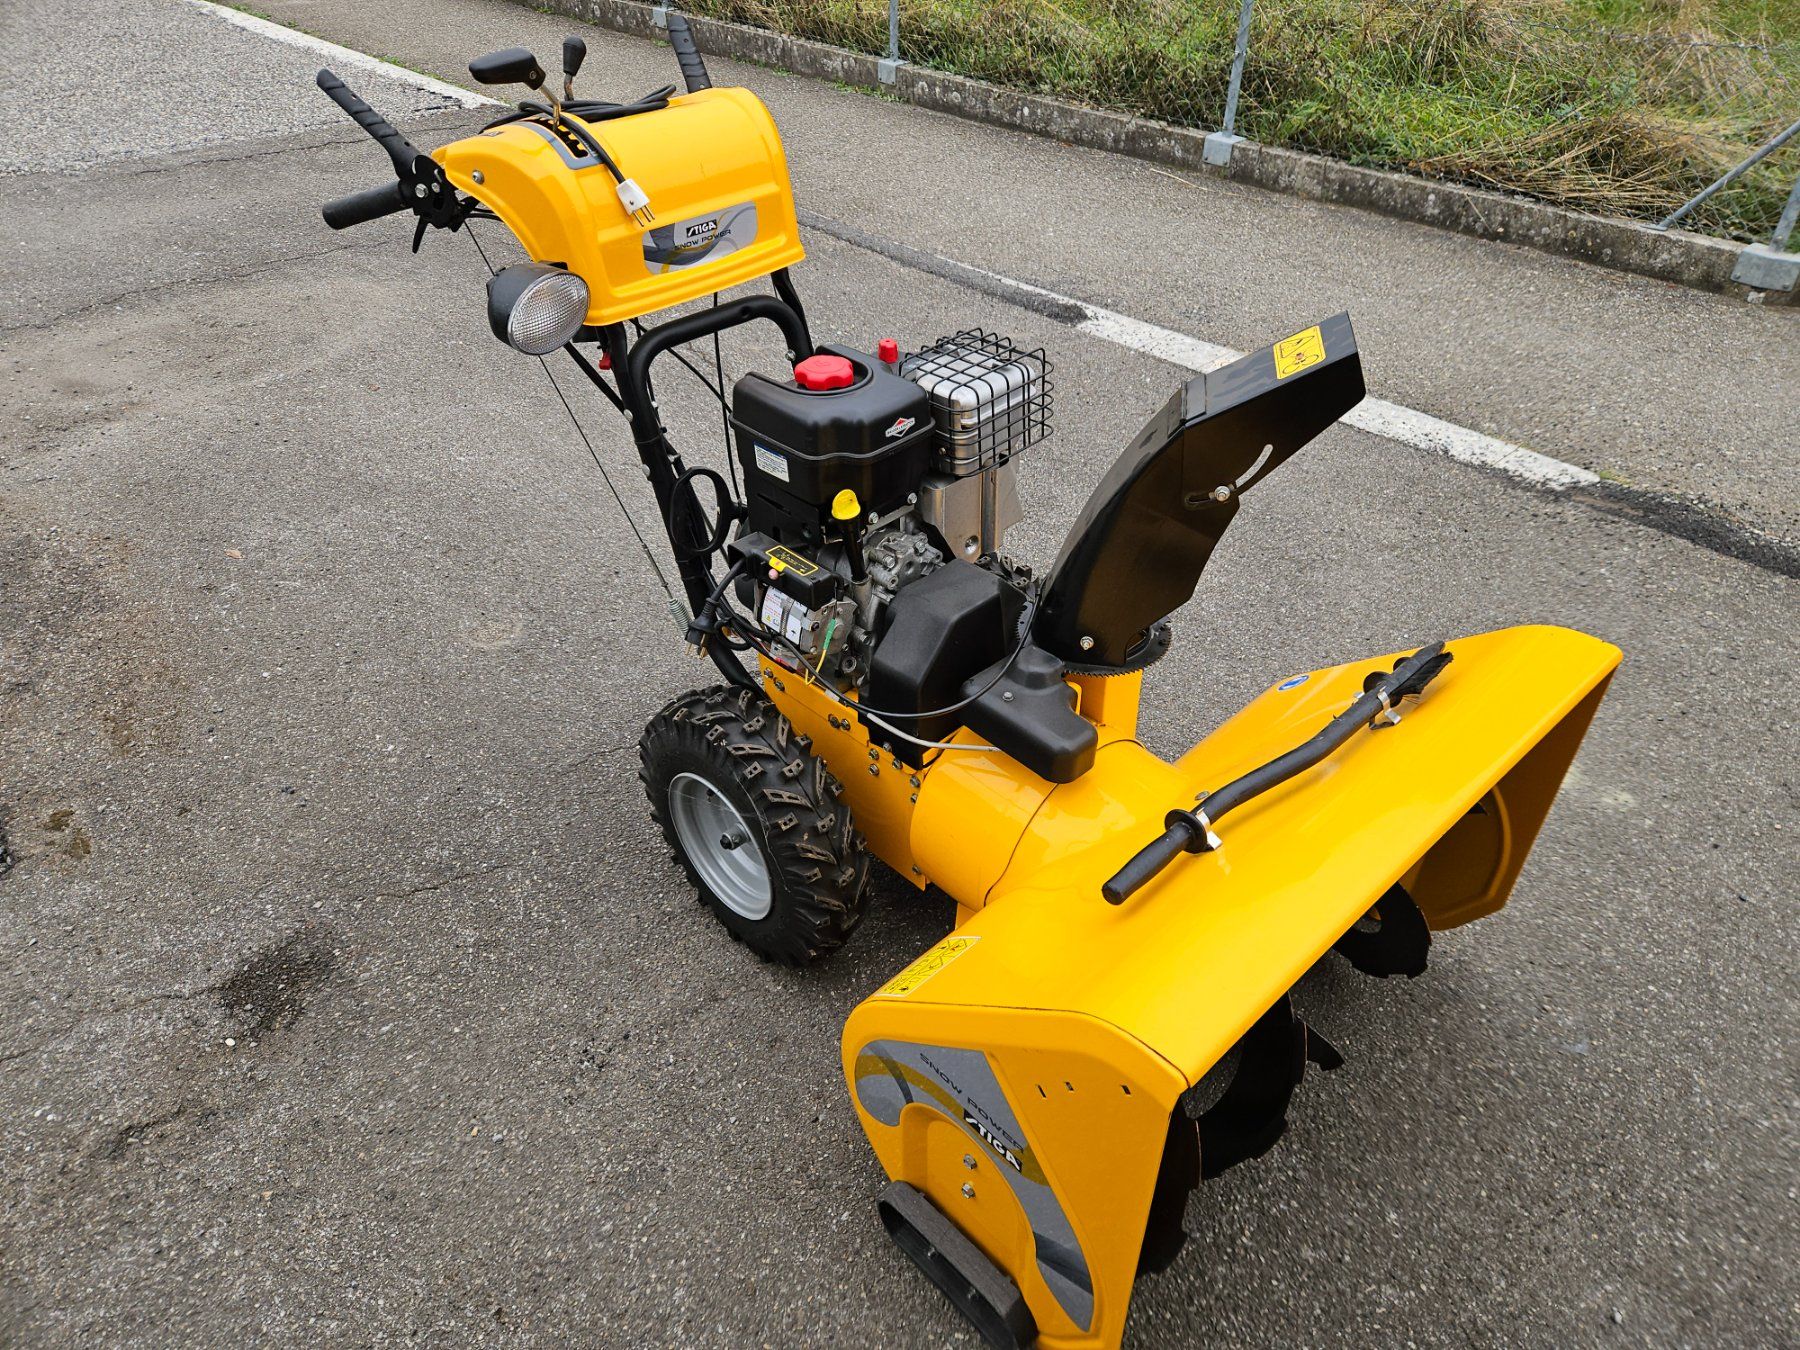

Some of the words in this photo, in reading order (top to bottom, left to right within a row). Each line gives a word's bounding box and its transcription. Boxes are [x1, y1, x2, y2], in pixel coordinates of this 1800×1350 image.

[674, 238, 700, 250] SNOW
[701, 229, 732, 243] POWER
[687, 220, 717, 238] STIGA
[920, 1052, 962, 1094] SNOW
[967, 1096, 1024, 1154] POWER
[965, 1115, 1022, 1172] STIGA
